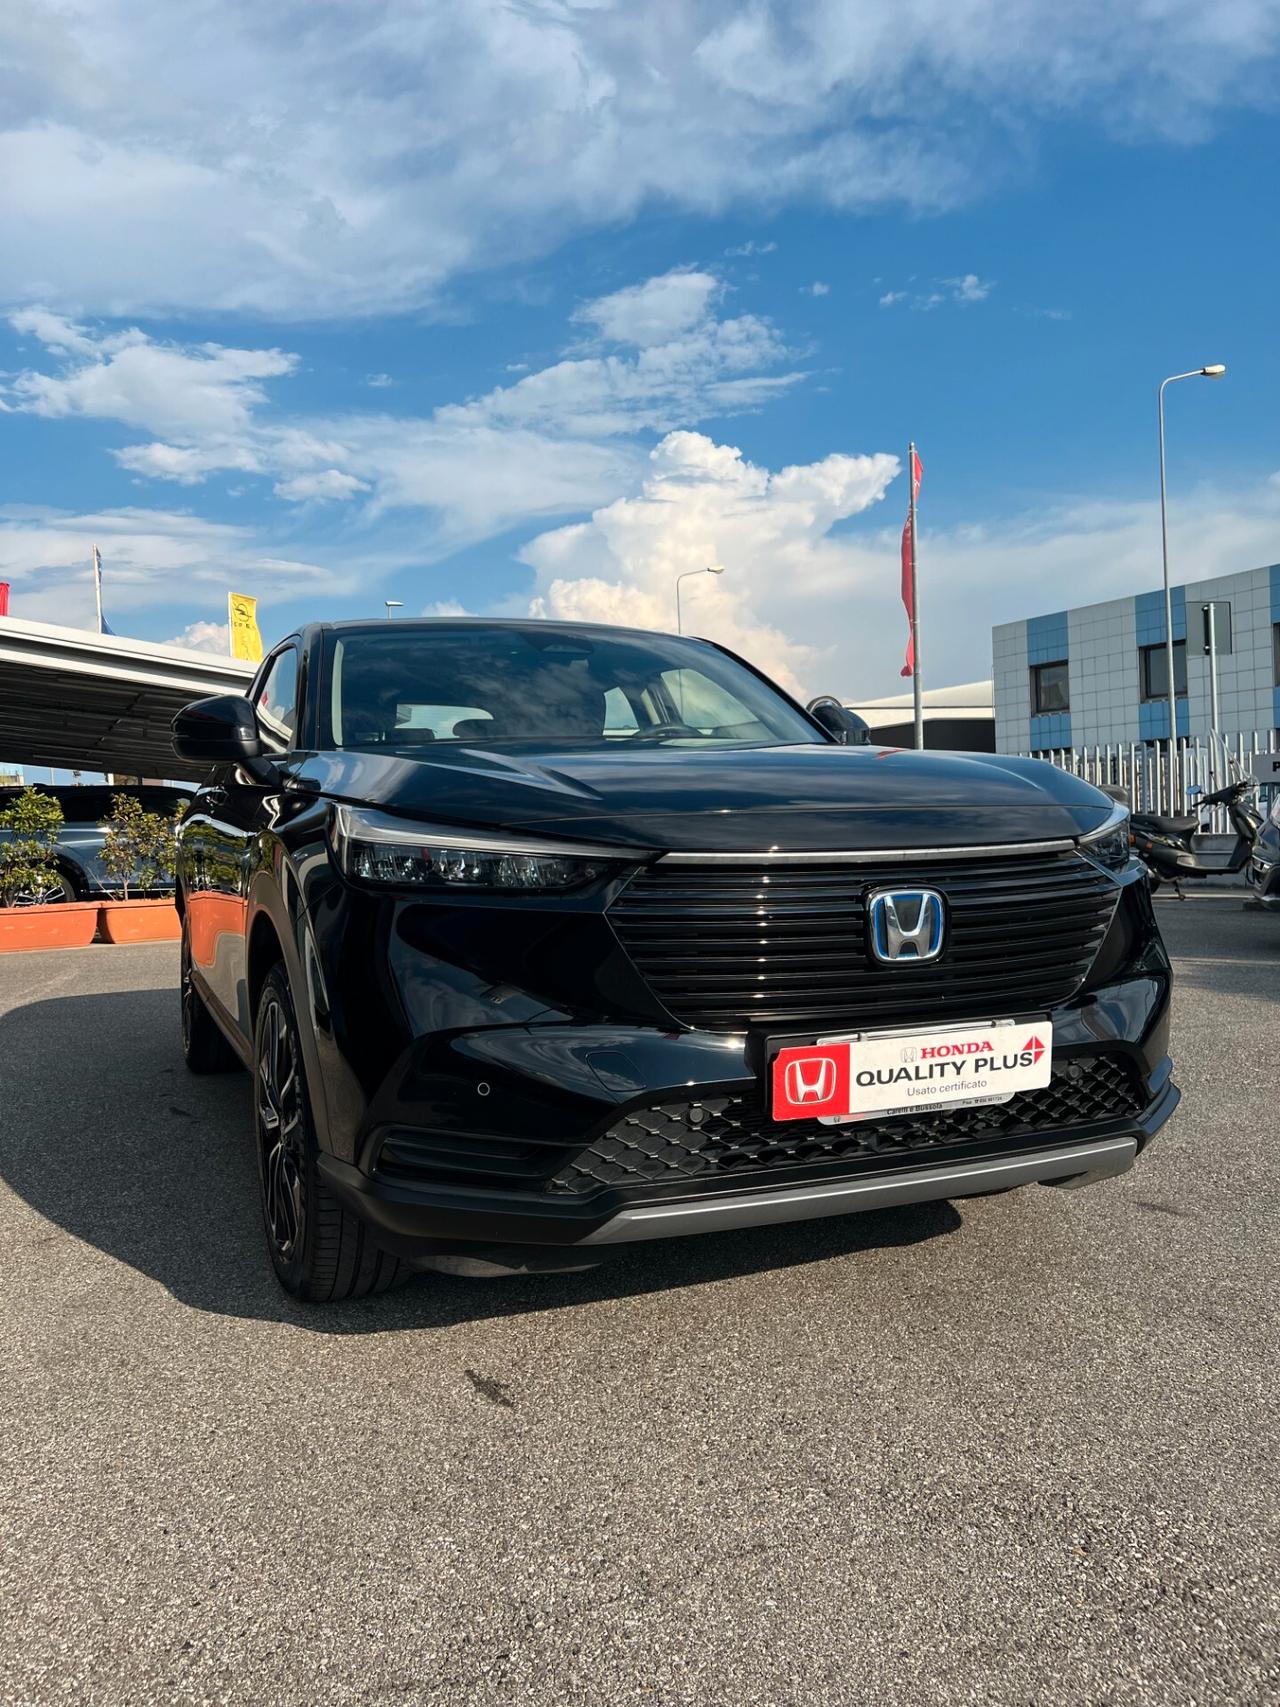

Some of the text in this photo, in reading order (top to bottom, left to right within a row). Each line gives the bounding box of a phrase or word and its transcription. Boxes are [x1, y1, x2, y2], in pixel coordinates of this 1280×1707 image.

[920, 1041, 994, 1059] HONDA
[856, 1052, 1033, 1087] QUALITY PLUS
[907, 1079, 987, 1097] Usato certificato
